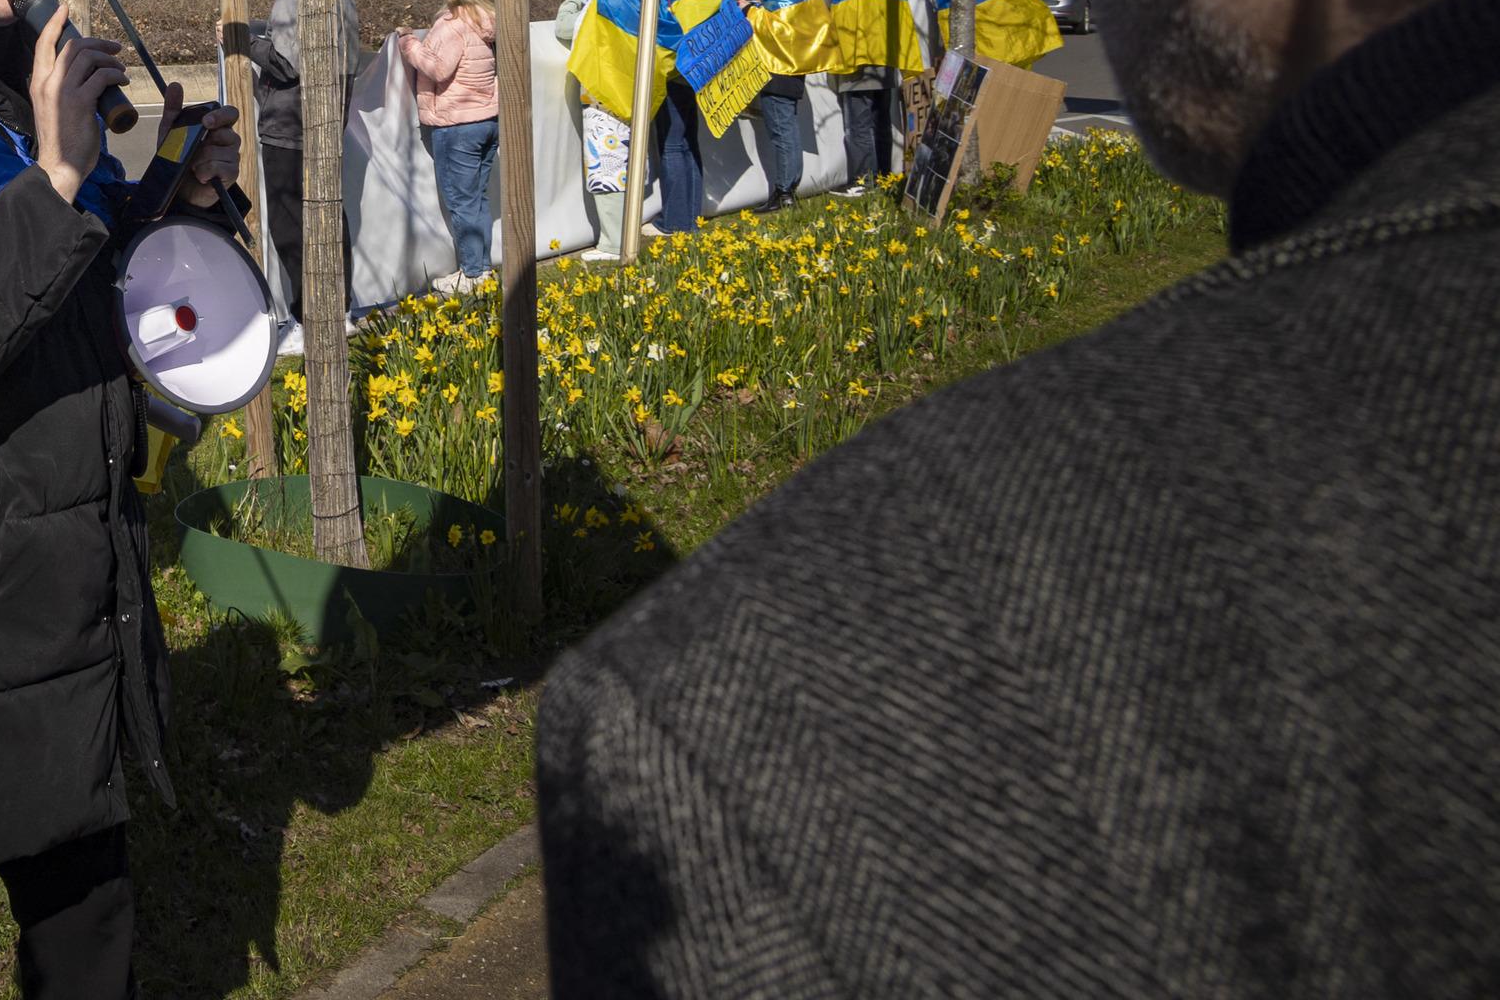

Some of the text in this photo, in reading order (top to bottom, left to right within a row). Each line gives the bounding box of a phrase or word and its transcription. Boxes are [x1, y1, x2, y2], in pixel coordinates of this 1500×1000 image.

[686, 18, 723, 59] RUSSIA
[698, 84, 717, 114] GIVE
[709, 90, 742, 136] PROTECT
